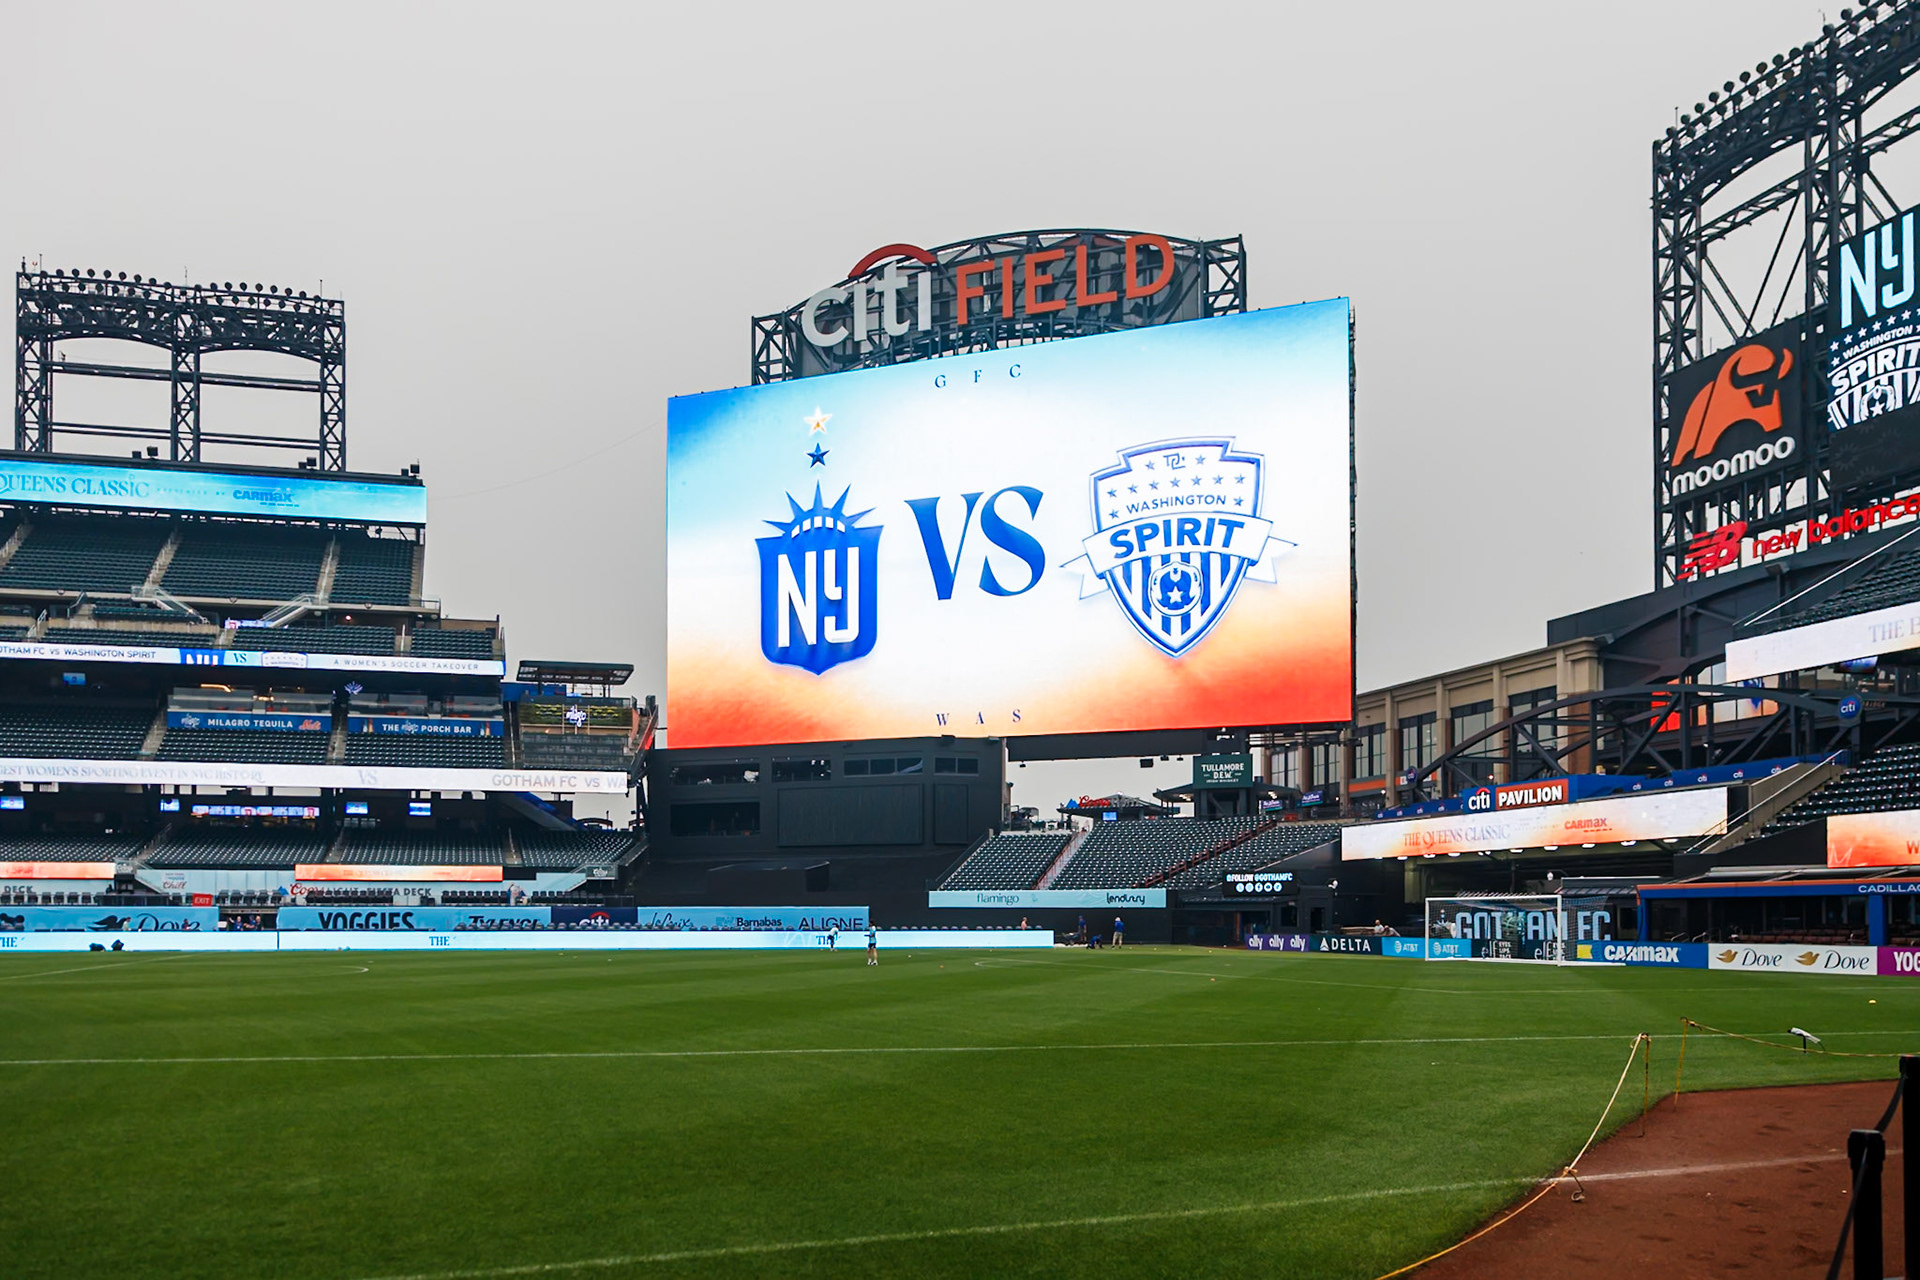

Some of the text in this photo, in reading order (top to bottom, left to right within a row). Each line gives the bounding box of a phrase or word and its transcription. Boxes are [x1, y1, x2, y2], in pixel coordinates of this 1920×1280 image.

[956, 233, 1176, 326] FIELD
[801, 259, 932, 348] citi
[1842, 324, 1914, 360] WASHINGTON
[1831, 341, 1920, 396] SPIRIT
[1672, 436, 1796, 497] moomoo
[71, 476, 150, 498] CLASSIC
[1126, 494, 1227, 514] WASHINGTON
[1752, 494, 1920, 558] new balance
[904, 485, 1046, 600] VS
[1109, 517, 1246, 560] SPIRIT
[1868, 619, 1904, 643] THE
[33, 647, 45, 655] FC
[64, 650, 125, 658] WASHINGTON
[127, 651, 156, 659] SPIRIT
[233, 652, 247, 663] VS
[432, 663, 480, 671] TAKEOVER
[207, 718, 250, 727] MILAGRO
[253, 719, 293, 728] TEQUILA
[382, 723, 399, 732] THE
[421, 725, 451, 733] PORCH
[81, 767, 138, 778] SPORTING
[141, 769, 174, 779] EVENT
[1201, 763, 1244, 772] TULLAMORE
[358, 770, 379, 785] VS
[492, 774, 555, 788] GOTHAM
[560, 776, 577, 788] FC
[584, 777, 600, 788] VS
[1468, 785, 1563, 811] citi PAVILION
[1403, 832, 1421, 847] THE
[1423, 829, 1463, 849] QUEENS
[1465, 824, 1511, 842] CLASSIC
[4, 885, 33, 894] DECK
[403, 888, 431, 896] DECK
[977, 893, 1020, 905] flamingo
[736, 916, 782, 927] Barnabas
[800, 917, 863, 930] ALIGNE
[1577, 911, 1611, 941] FC
[429, 936, 451, 946] THE
[1249, 935, 1306, 951] ally ally ally
[1331, 938, 1371, 952] DELTA
[1402, 943, 1459, 954] AT&T AT&T
[1741, 948, 1870, 970] Dove Dove
